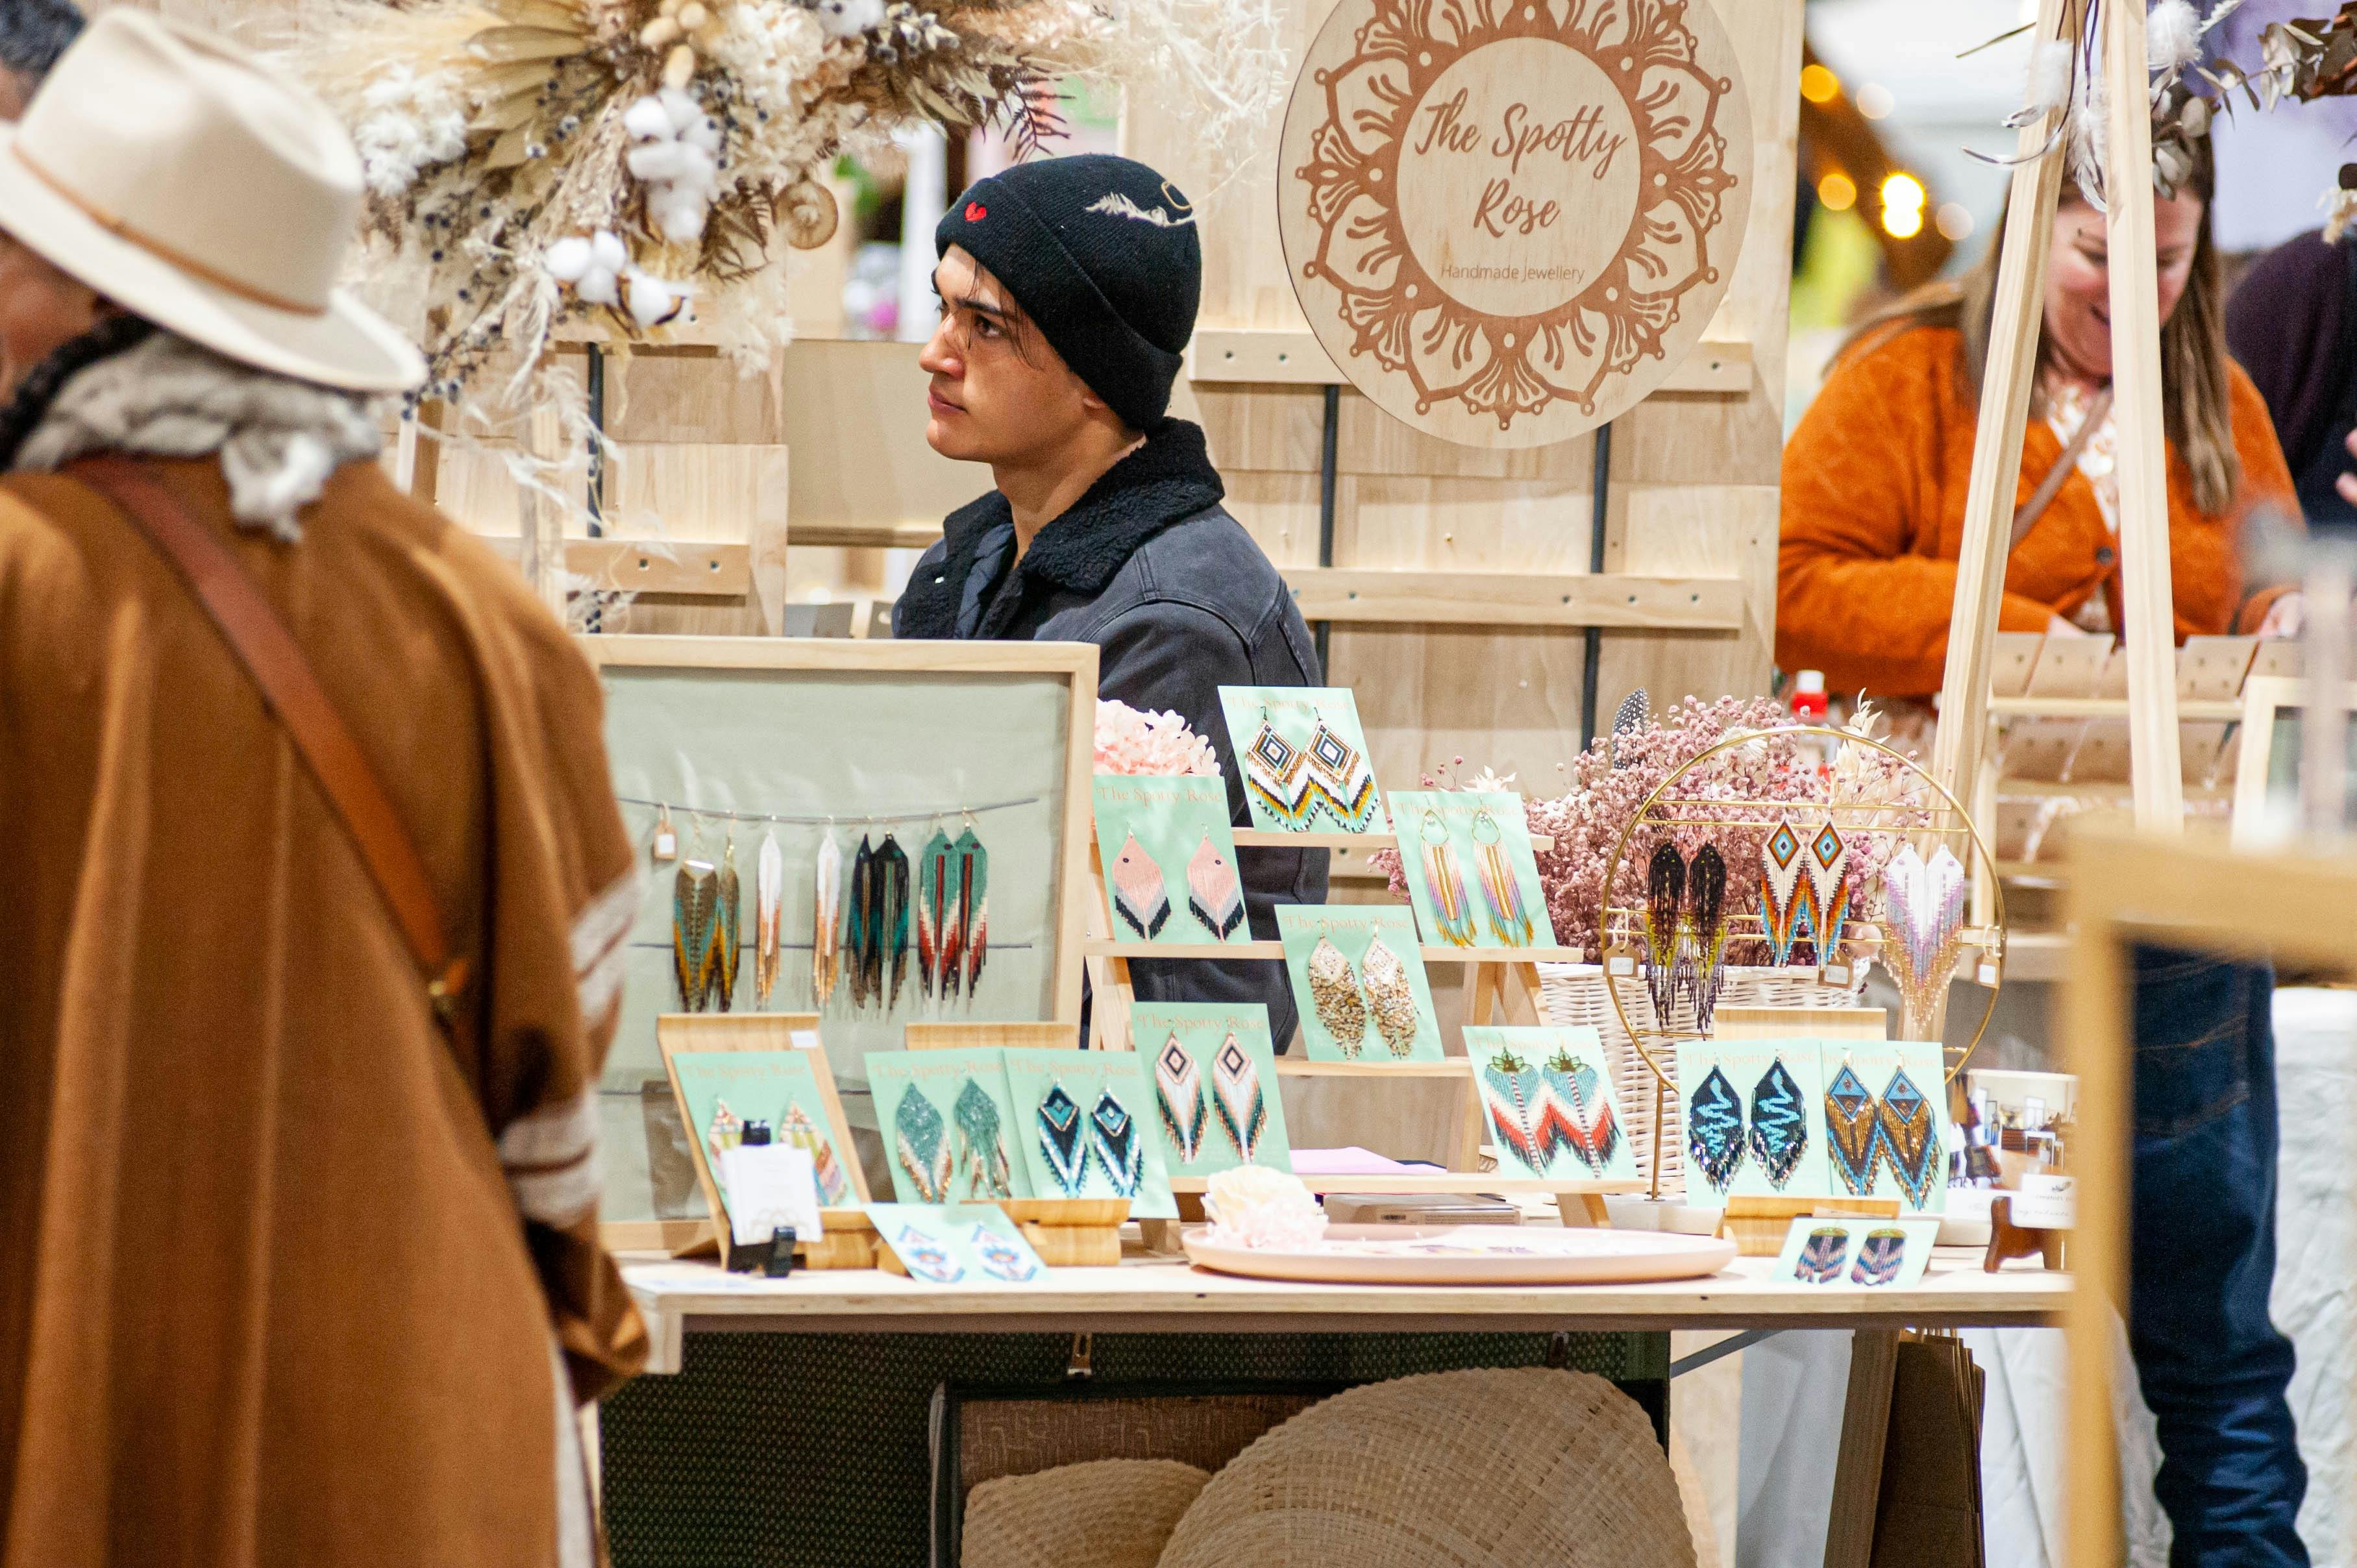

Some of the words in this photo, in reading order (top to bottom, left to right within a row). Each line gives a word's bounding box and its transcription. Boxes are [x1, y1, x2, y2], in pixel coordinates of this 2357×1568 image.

[1414, 87, 1483, 154] The
[1492, 102, 1627, 180] Spotty
[1473, 177, 1561, 238] Rose
[1440, 263, 1519, 280] Handmade
[1522, 263, 1585, 284] Jewellery
[1096, 786, 1129, 800] The
[1134, 789, 1181, 809] Spotty
[1187, 789, 1223, 802] Rose
[1284, 915, 1318, 928] The
[1322, 917, 1368, 935] Spotty
[1372, 916, 1410, 929] Rose
[1137, 1013, 1168, 1029] The
[1174, 1015, 1222, 1035] Spotty
[1226, 1016, 1264, 1029] Rose
